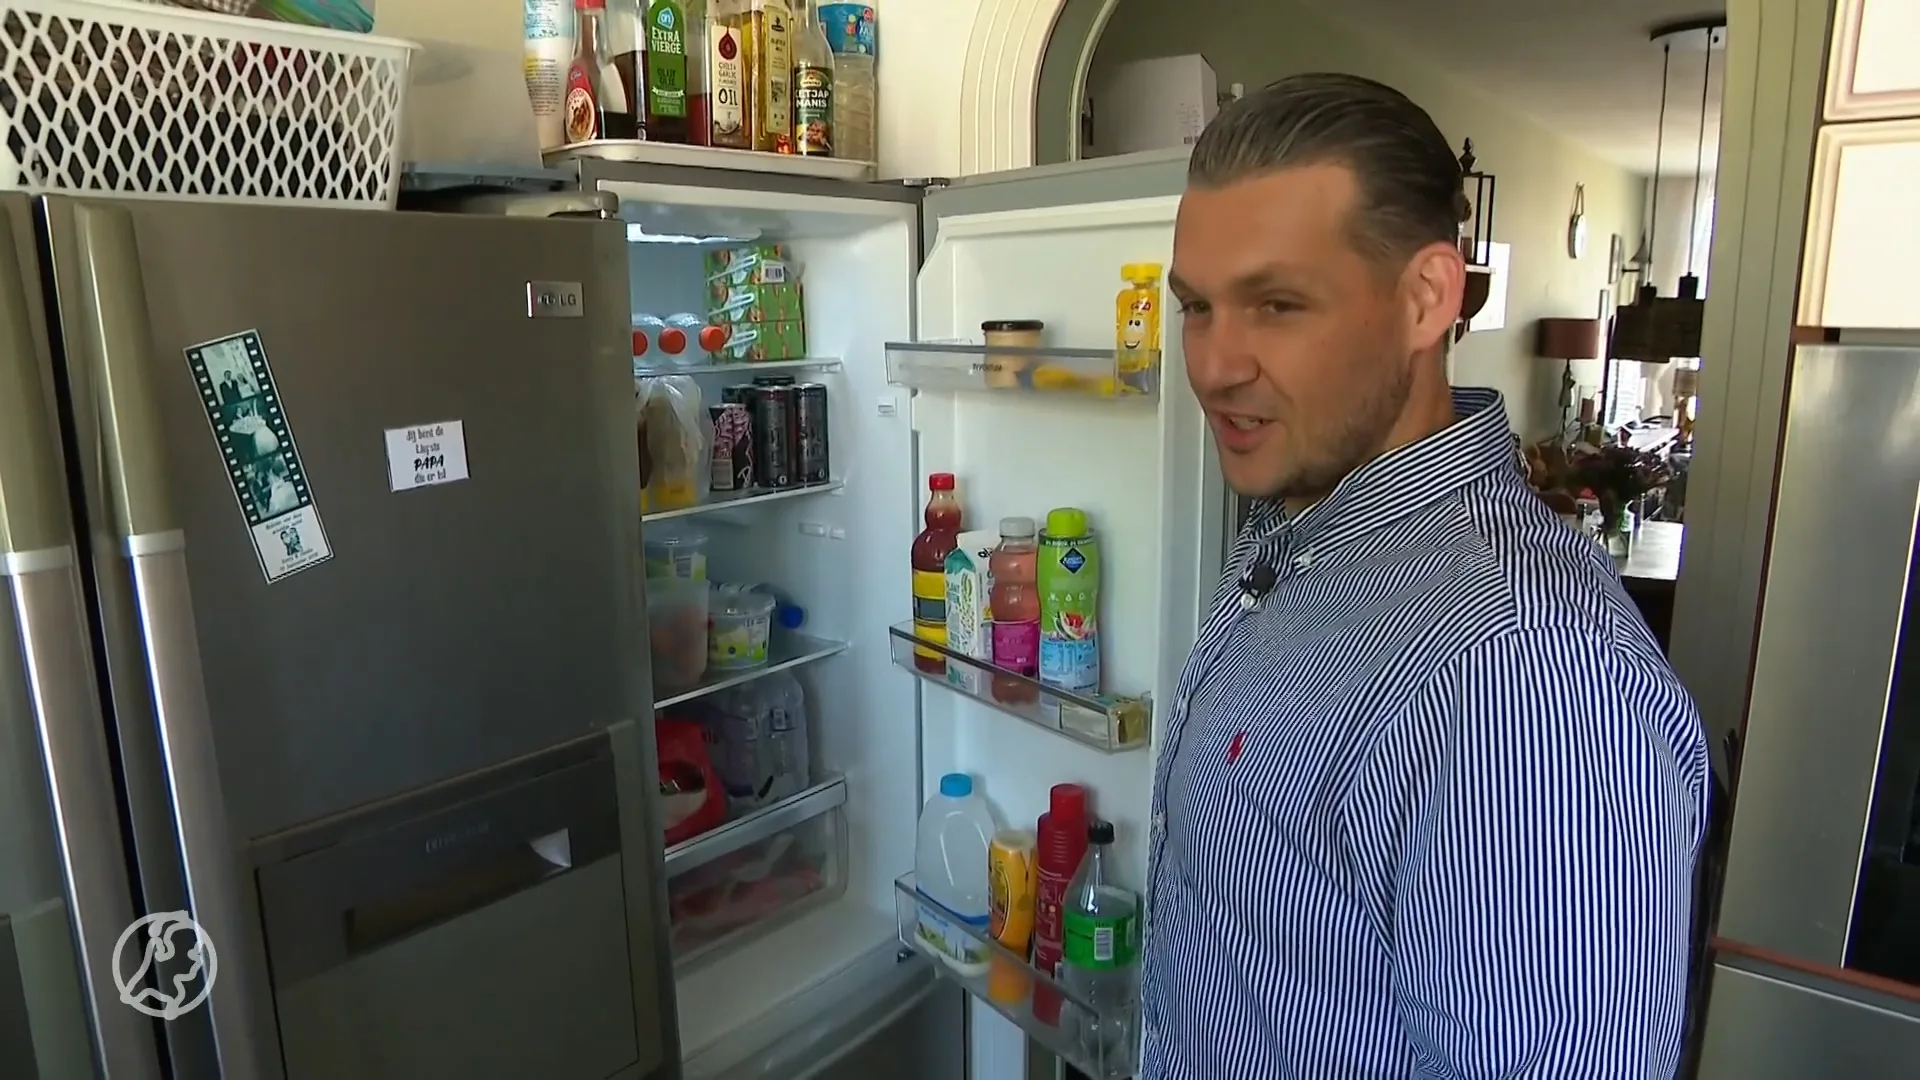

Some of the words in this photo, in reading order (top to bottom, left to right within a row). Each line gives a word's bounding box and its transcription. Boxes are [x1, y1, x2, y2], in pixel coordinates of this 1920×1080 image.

[651, 26, 680, 43] EXTRA
[651, 40, 682, 54] VIERGE
[718, 88, 738, 106] OIL
[796, 99, 827, 108] MANIS
[559, 293, 577, 306] LG
[413, 454, 444, 471] PAPA
